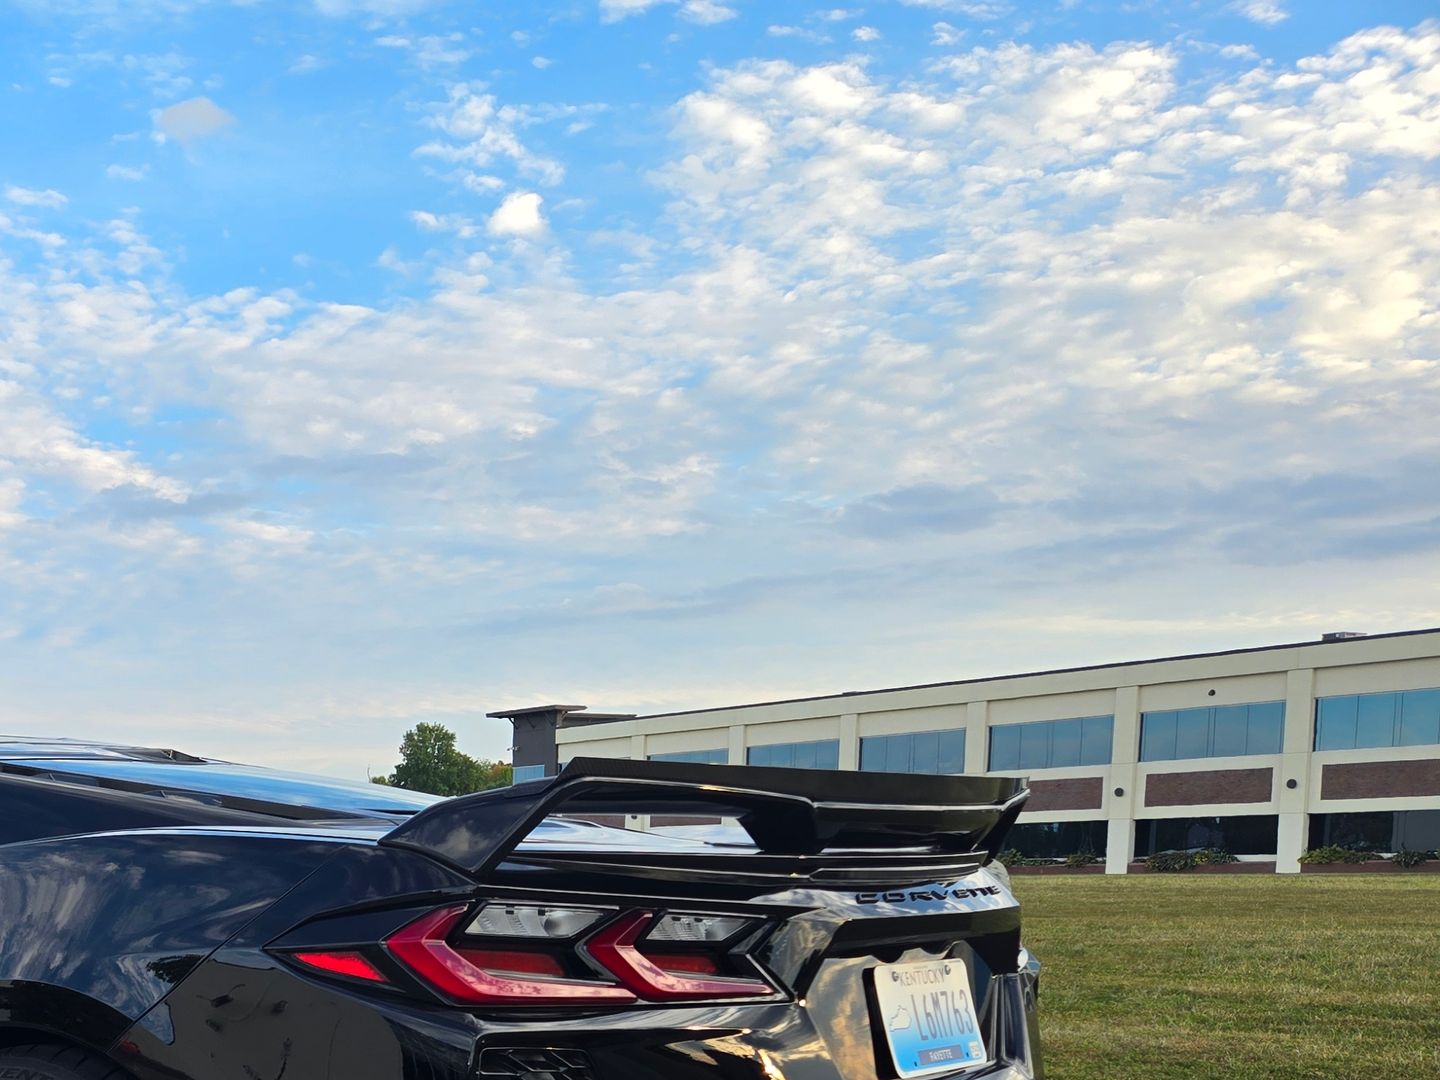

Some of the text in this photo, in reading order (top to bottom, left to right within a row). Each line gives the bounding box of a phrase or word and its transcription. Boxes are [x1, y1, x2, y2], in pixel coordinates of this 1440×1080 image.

[856, 885, 1001, 904] CORVETTE
[900, 967, 945, 987] KENTUCKY
[911, 989, 974, 1040] L6M763
